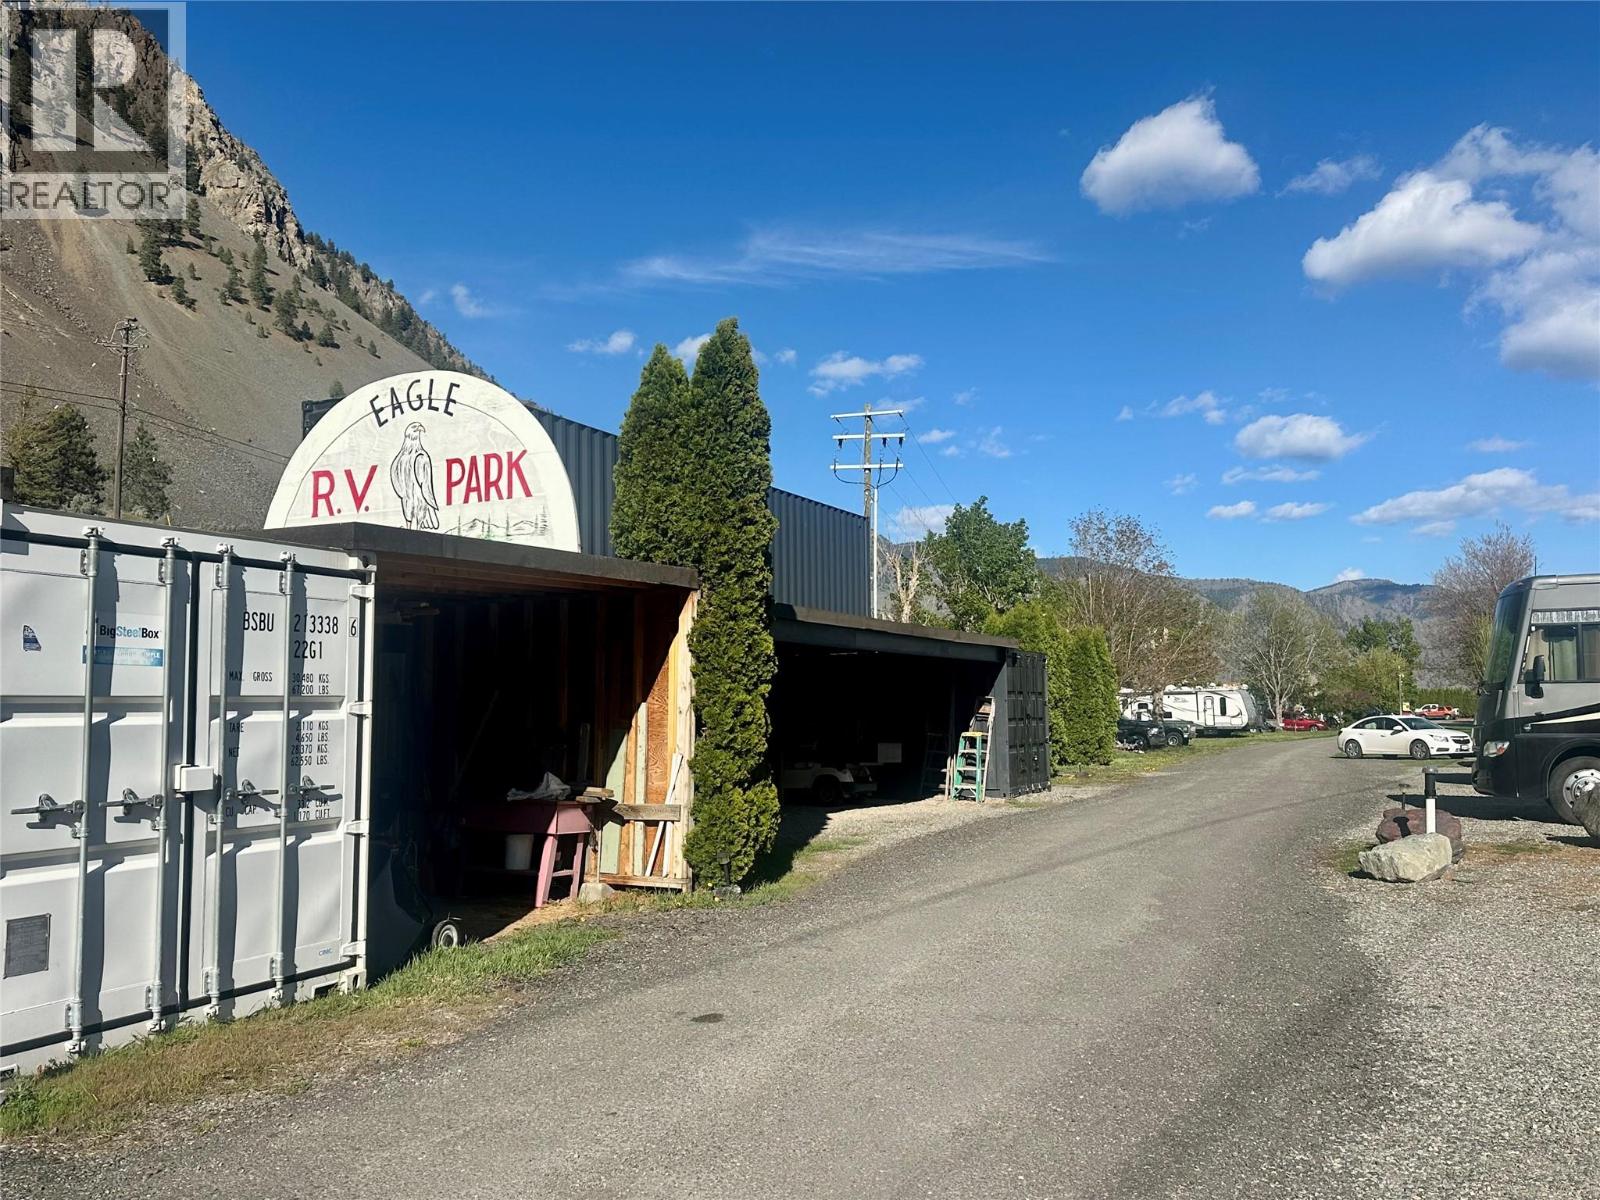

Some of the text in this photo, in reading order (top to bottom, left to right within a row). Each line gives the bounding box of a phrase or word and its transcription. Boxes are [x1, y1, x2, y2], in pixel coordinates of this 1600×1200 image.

[369, 378, 461, 428] EAGLE
[311, 449, 533, 518] R.V. PARK
[100, 625, 160, 639] BigSteelBox
[243, 611, 357, 637] BSBU 213338 6
[293, 640, 323, 660] 22G1
[252, 671, 273, 682] GROSS
[229, 722, 244, 733] TARE
[228, 747, 240, 757] NET
